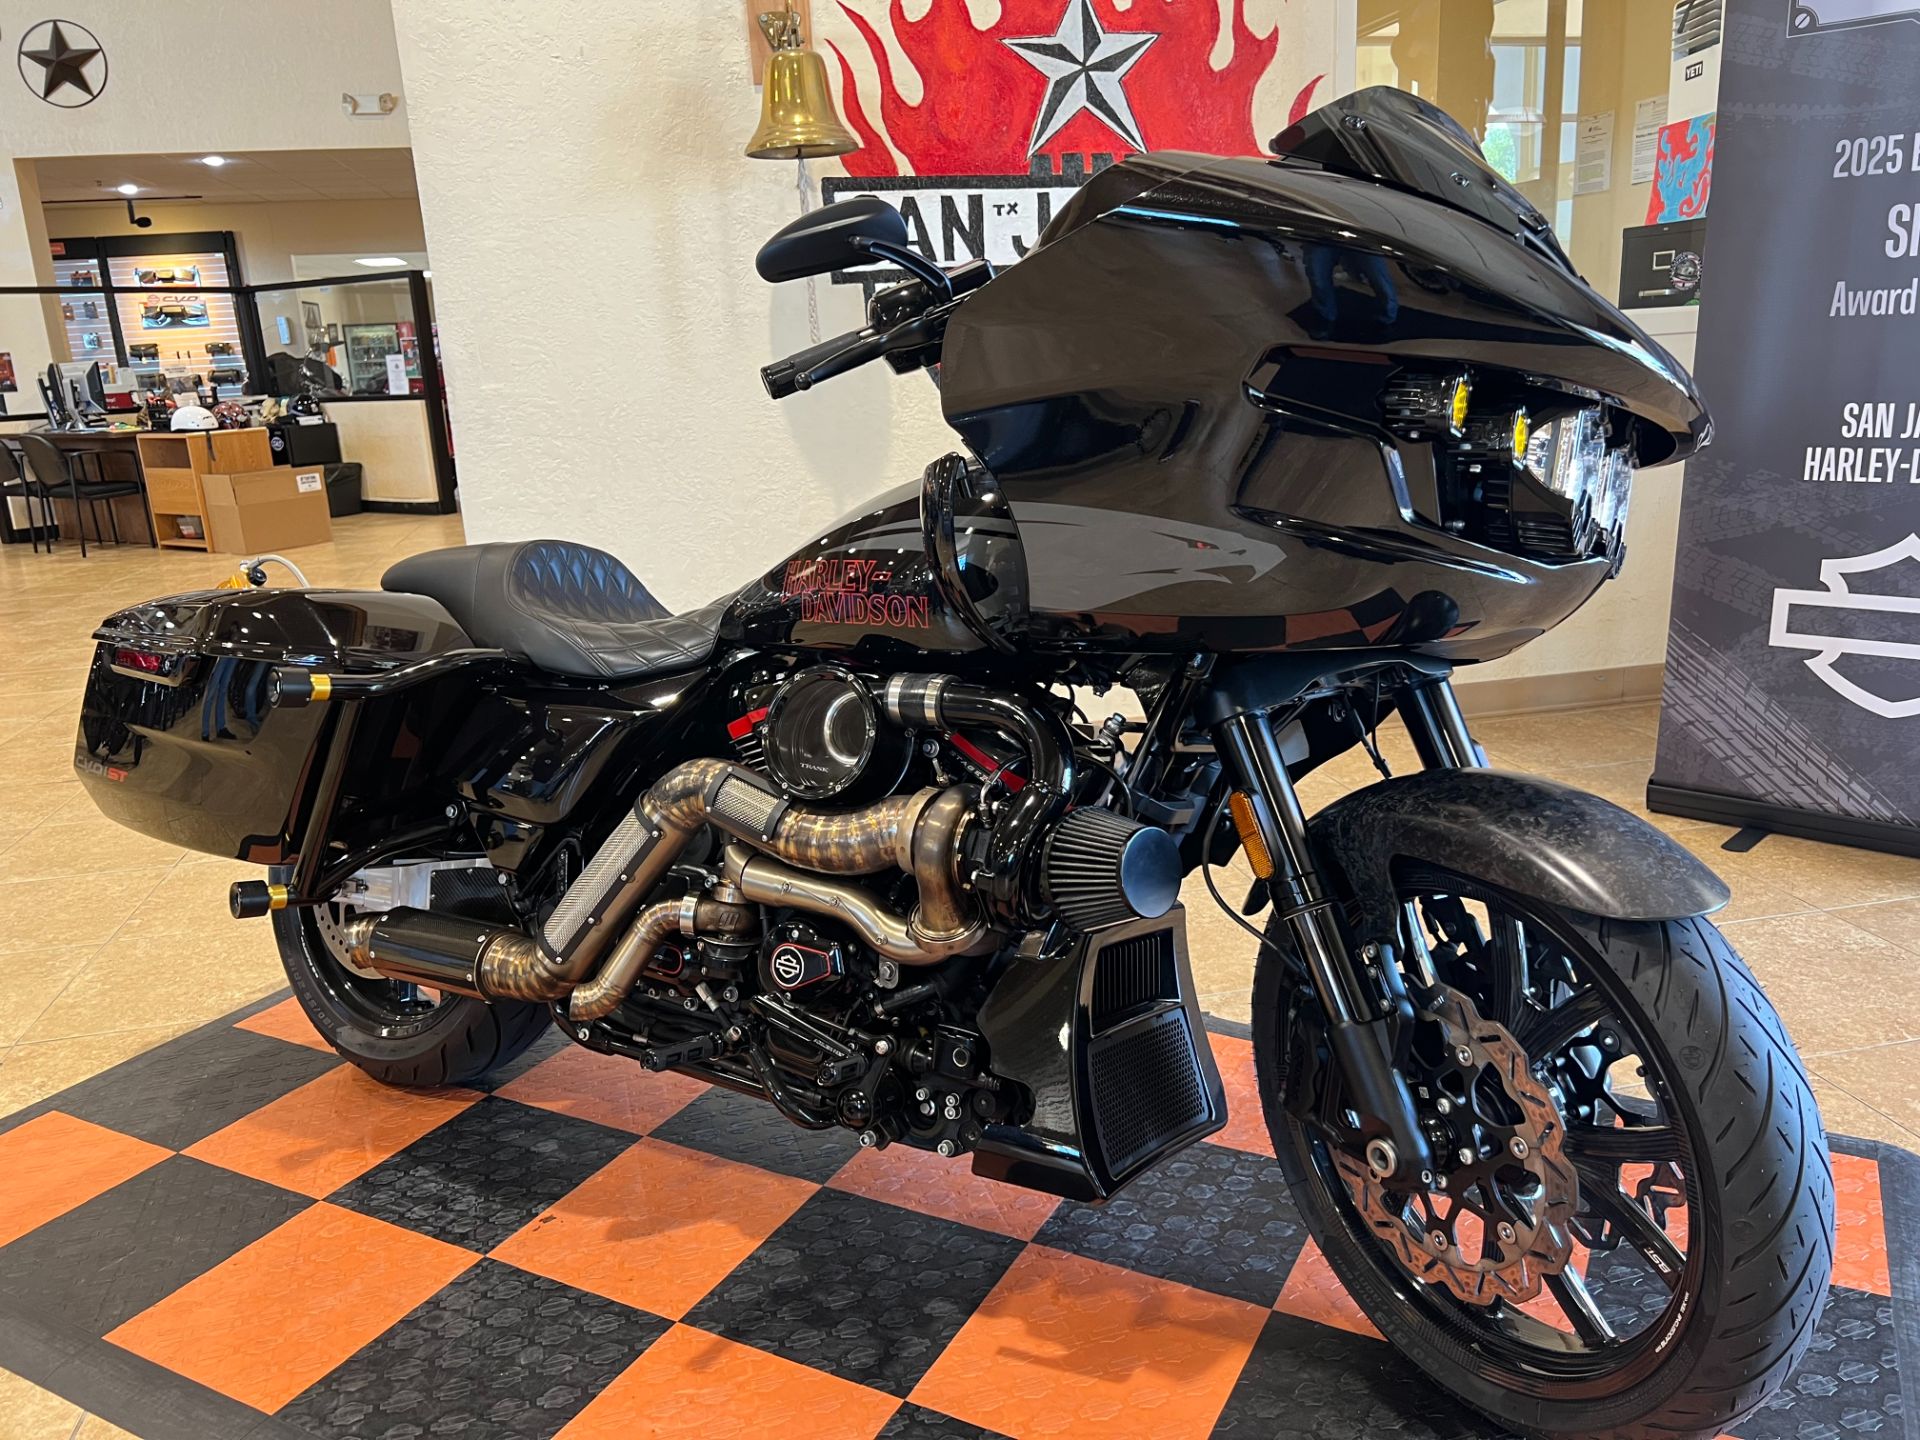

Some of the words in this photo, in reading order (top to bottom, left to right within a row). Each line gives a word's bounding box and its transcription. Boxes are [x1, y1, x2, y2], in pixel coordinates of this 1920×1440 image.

[1686, 63, 1702, 79] YETI
[1833, 134, 1904, 178] 2025
[993, 203, 1018, 216] TX
[1829, 278, 1918, 317] Award
[1842, 402, 1895, 438] SAN
[781, 560, 893, 603] HARLEY-
[801, 591, 929, 629] DAVIDSON
[800, 762, 829, 773] TRASK
